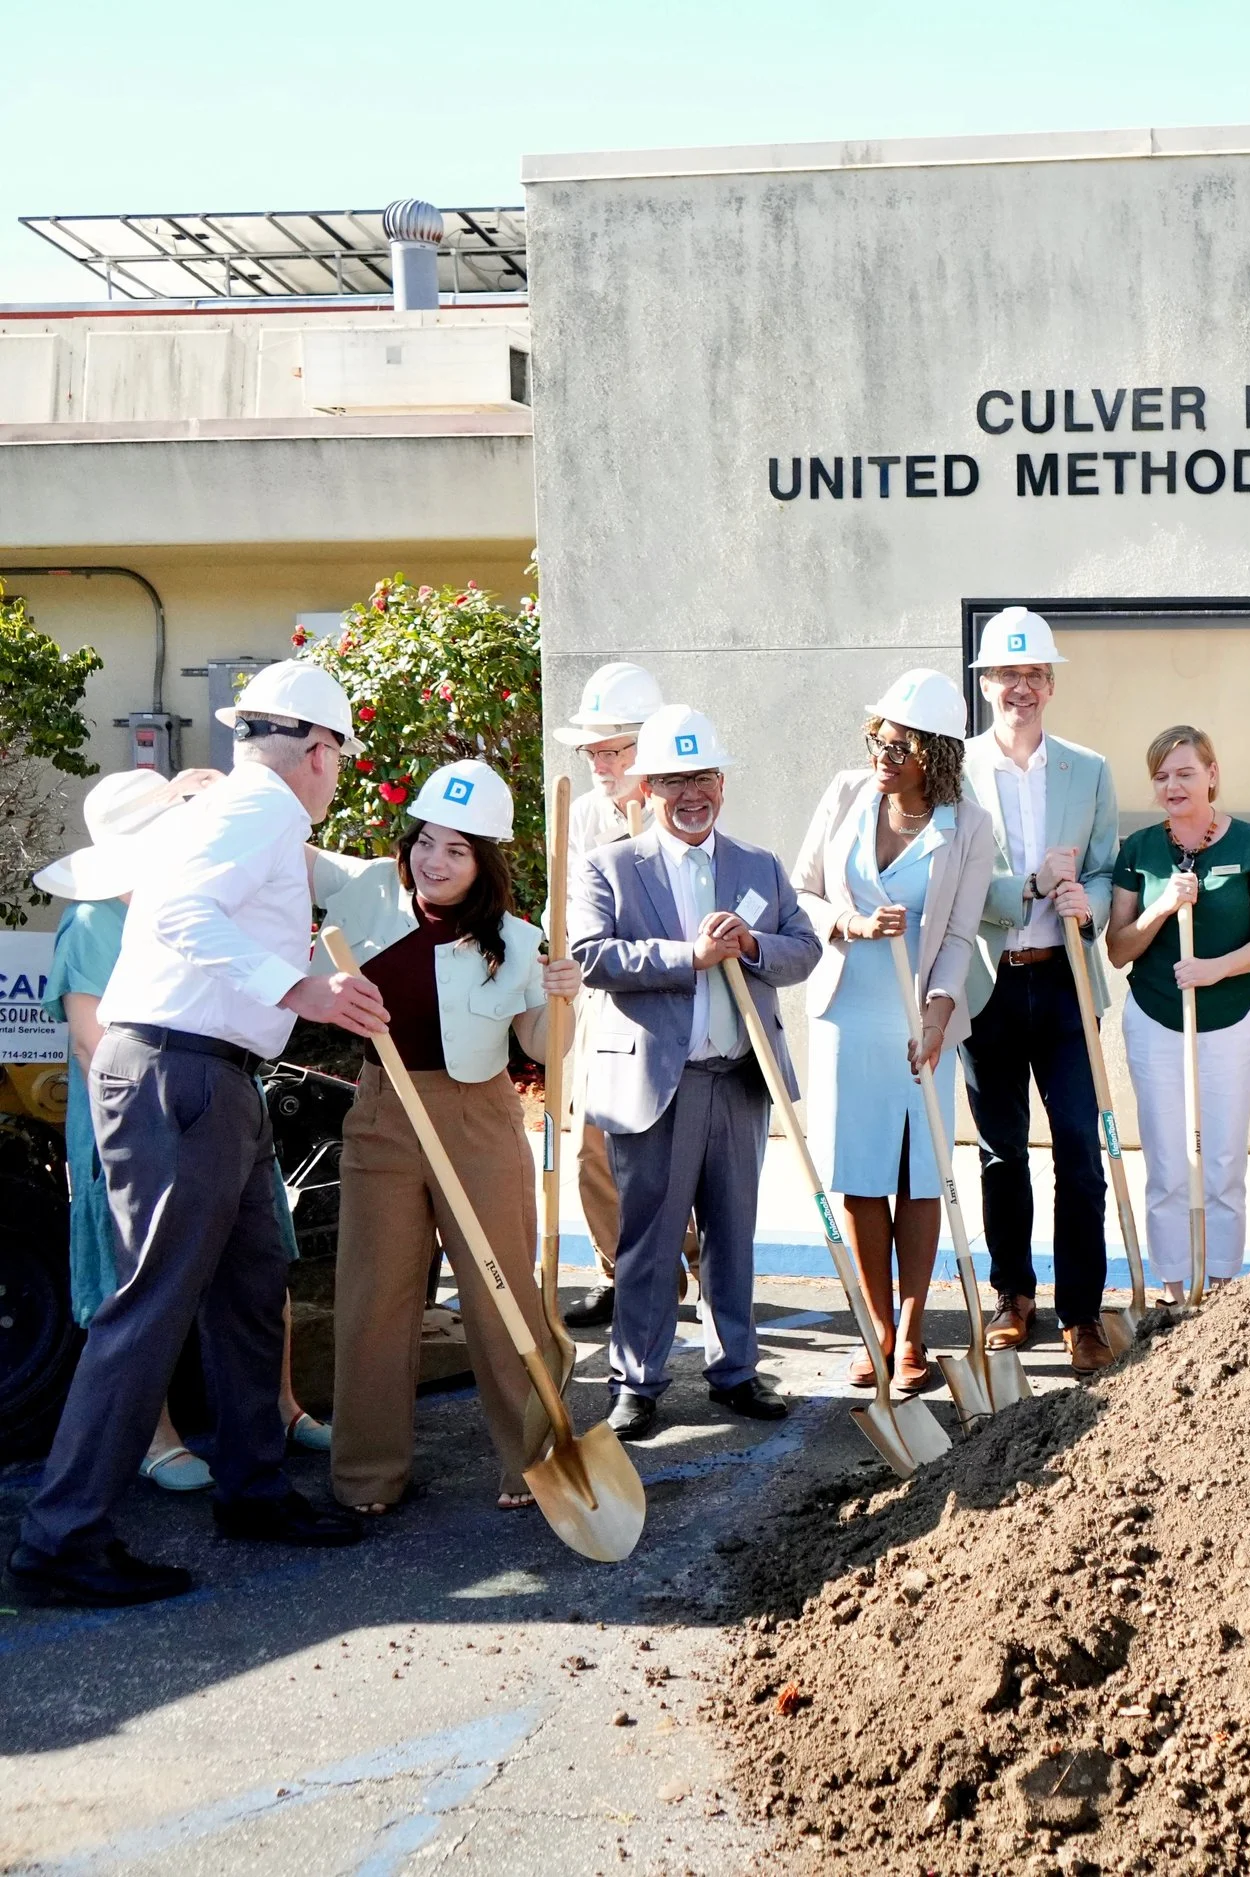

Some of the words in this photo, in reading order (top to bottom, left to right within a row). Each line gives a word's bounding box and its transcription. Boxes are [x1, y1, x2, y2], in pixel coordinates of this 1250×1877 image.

[977, 387, 1205, 434] CULVER
[770, 455, 978, 500] UNITED
[18, 1026, 55, 1034] Services
[2, 1051, 64, 1059] 714-921-4100
[820, 1196, 840, 1240] UnionTools
[485, 1260, 505, 1290] Anvil
